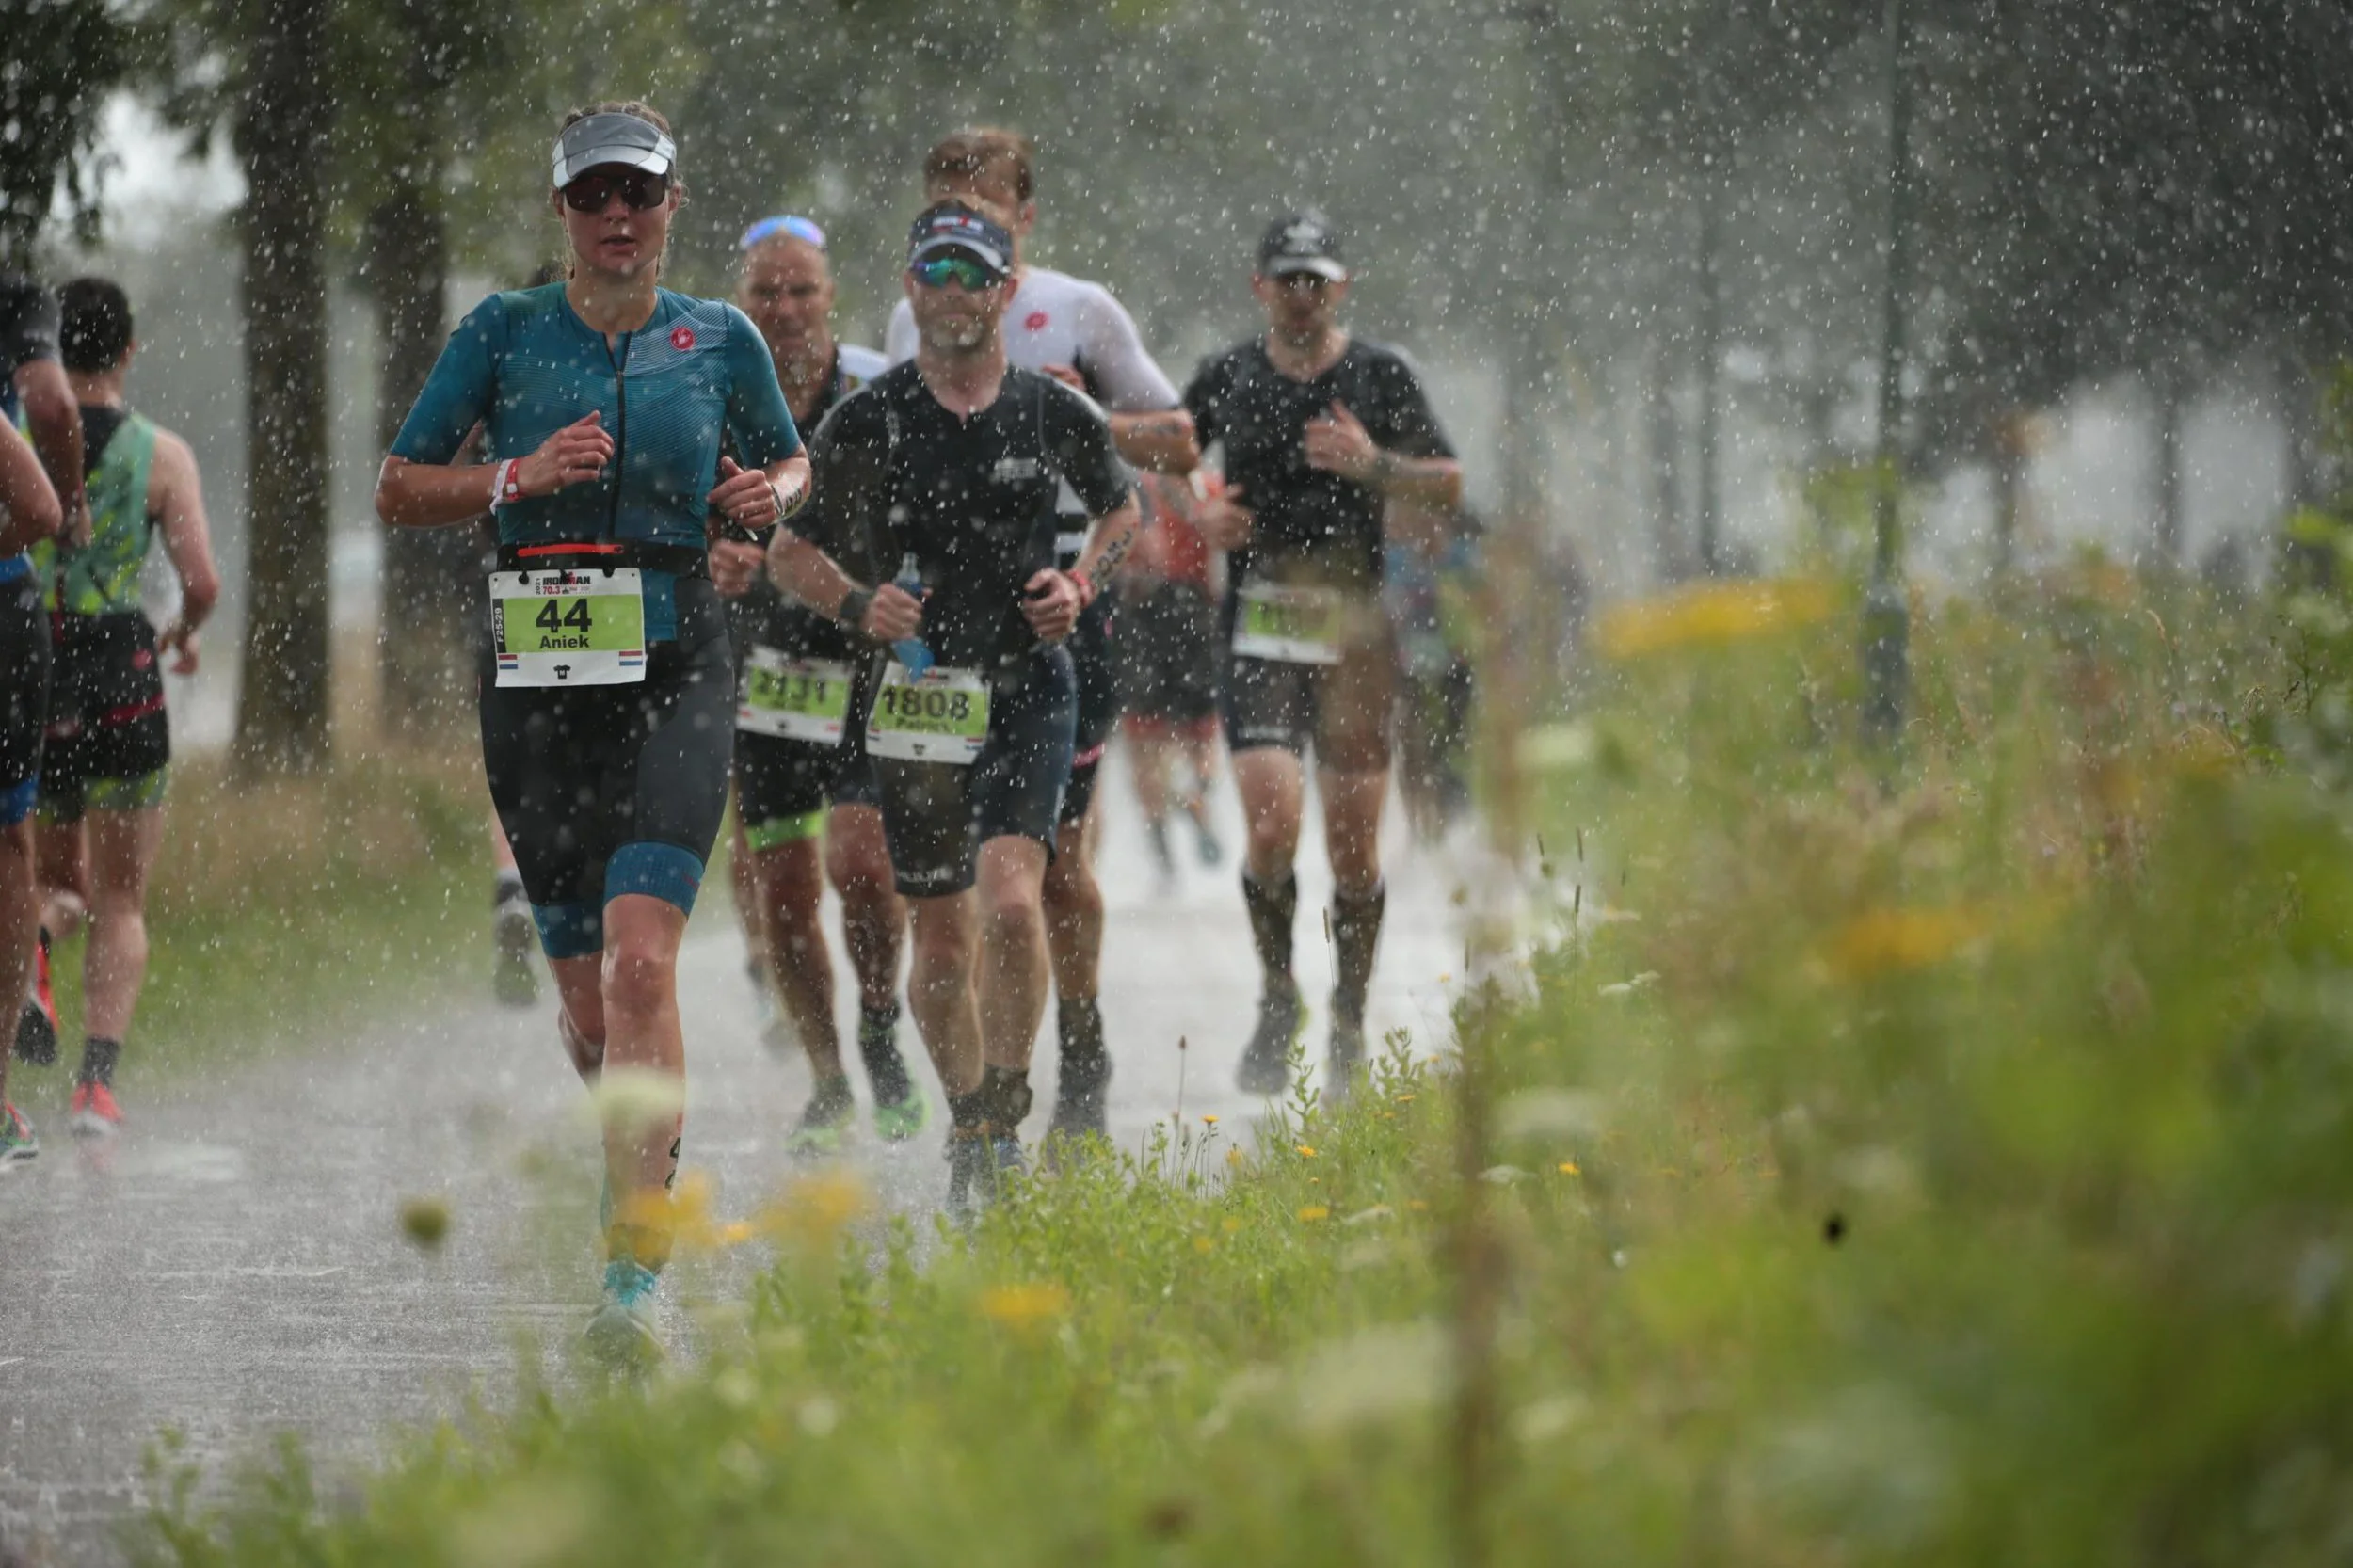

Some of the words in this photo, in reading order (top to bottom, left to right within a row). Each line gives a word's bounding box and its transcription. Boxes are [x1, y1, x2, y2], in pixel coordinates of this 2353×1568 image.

[543, 586, 561, 595] 70.3
[494, 607, 504, 643] F25-29
[536, 598, 593, 633] 44
[539, 634, 590, 649] Aniek
[882, 685, 969, 721] 1808
